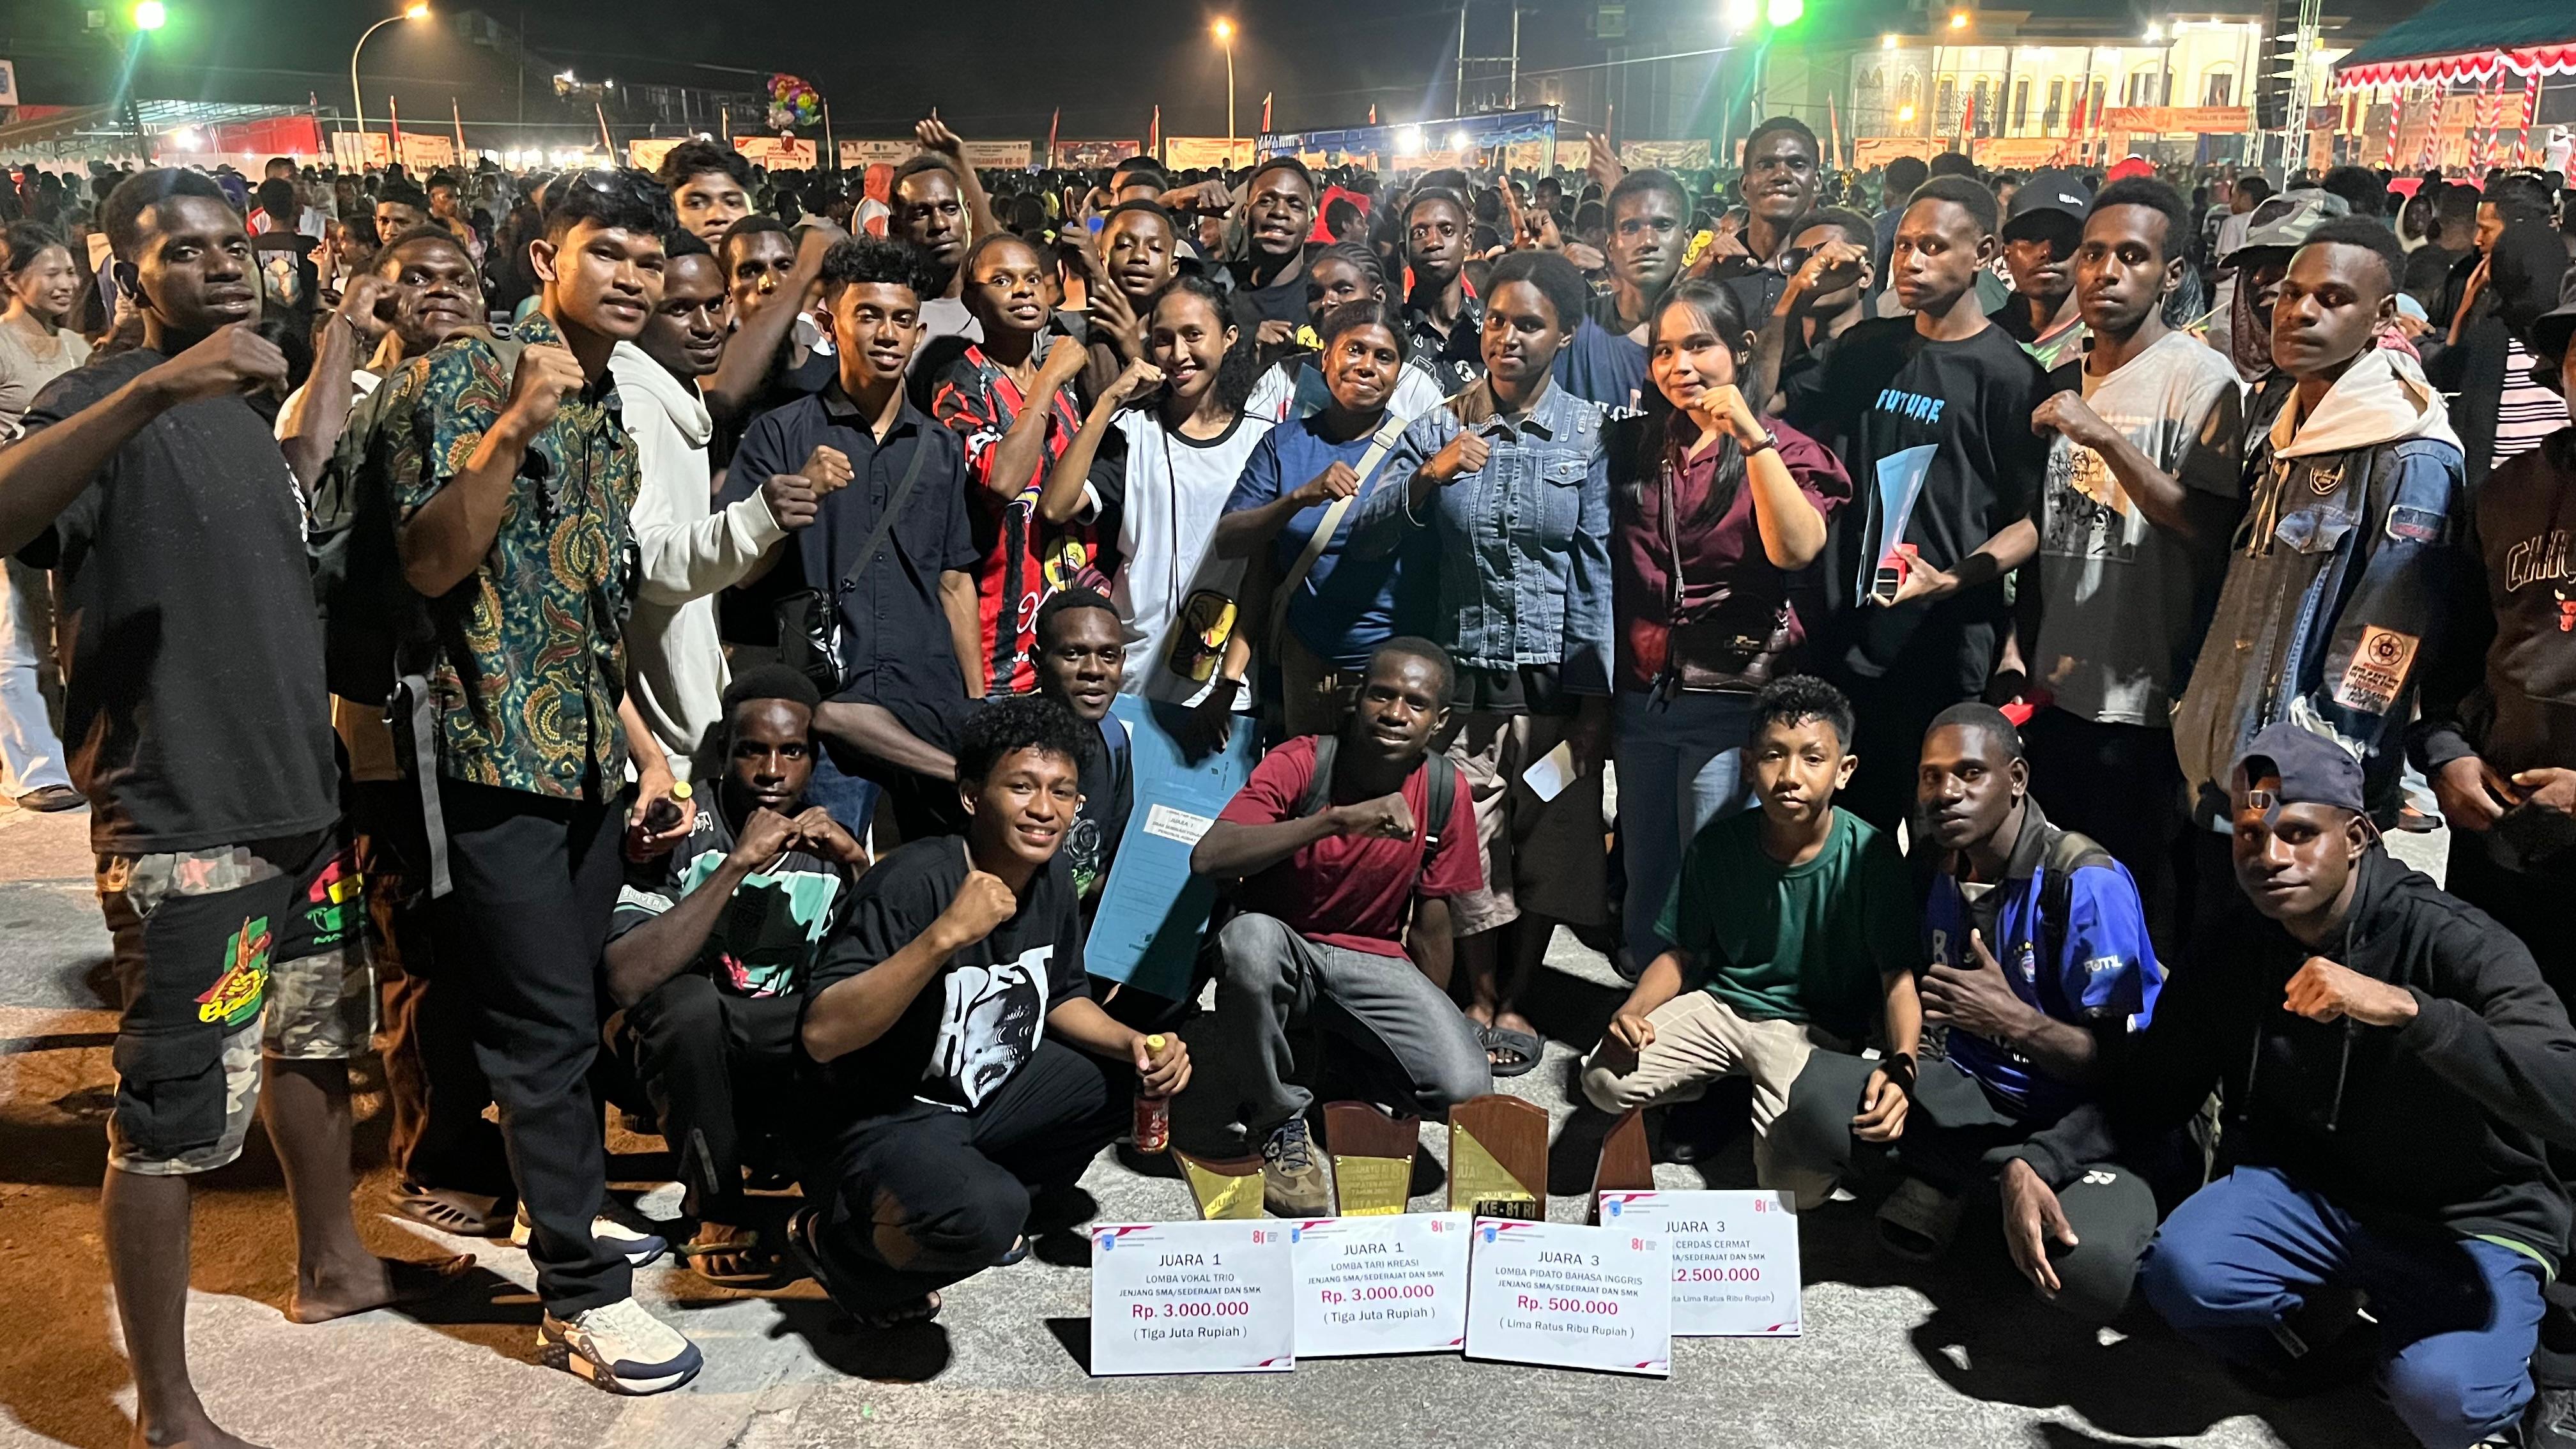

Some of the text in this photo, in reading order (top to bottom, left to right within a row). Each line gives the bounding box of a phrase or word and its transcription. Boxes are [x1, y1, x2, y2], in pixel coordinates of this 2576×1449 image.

[1875, 388, 1945, 424] FUTURE
[1481, 1200, 1498, 1215] KE
[1506, 1202, 1519, 1217] 81
[1523, 1203, 1535, 1218] RI
[1665, 1221, 1725, 1233] JUARA 3
[1344, 1241, 1404, 1255] JUARA 1
[1676, 1240, 1751, 1249] CERDAS CERMAT
[1158, 1253, 1222, 1267] JUARA 1
[1331, 1259, 1419, 1271] LOMBA TARI KREASI
[1538, 1251, 1599, 1266] JUARA 3
[1146, 1273, 1234, 1284] LOMBA VOKAL TRIO
[1308, 1275, 1341, 1285] JENJANG
[1342, 1272, 1406, 1282] SMA/SEDERAJAT
[1495, 1267, 1643, 1285] LOMBA PIDATO BAHASA INGGRIS
[1119, 1289, 1154, 1297] JENJANG
[1155, 1287, 1222, 1298] SMA/SEDERAJAT
[1321, 1284, 1434, 1305] Rp. 3.000.000
[1498, 1280, 1639, 1297] JENJANG SMA/SEDERAJAT DAN SMK
[1133, 1301, 1248, 1321] Rp. 3.000.000
[1518, 1295, 1618, 1315] Rp. 500.000
[1359, 1310, 1383, 1321] Juta
[1169, 1327, 1193, 1338] Juta
[1535, 1321, 1563, 1331] Ratus
[1567, 1323, 1589, 1333] Ribu
